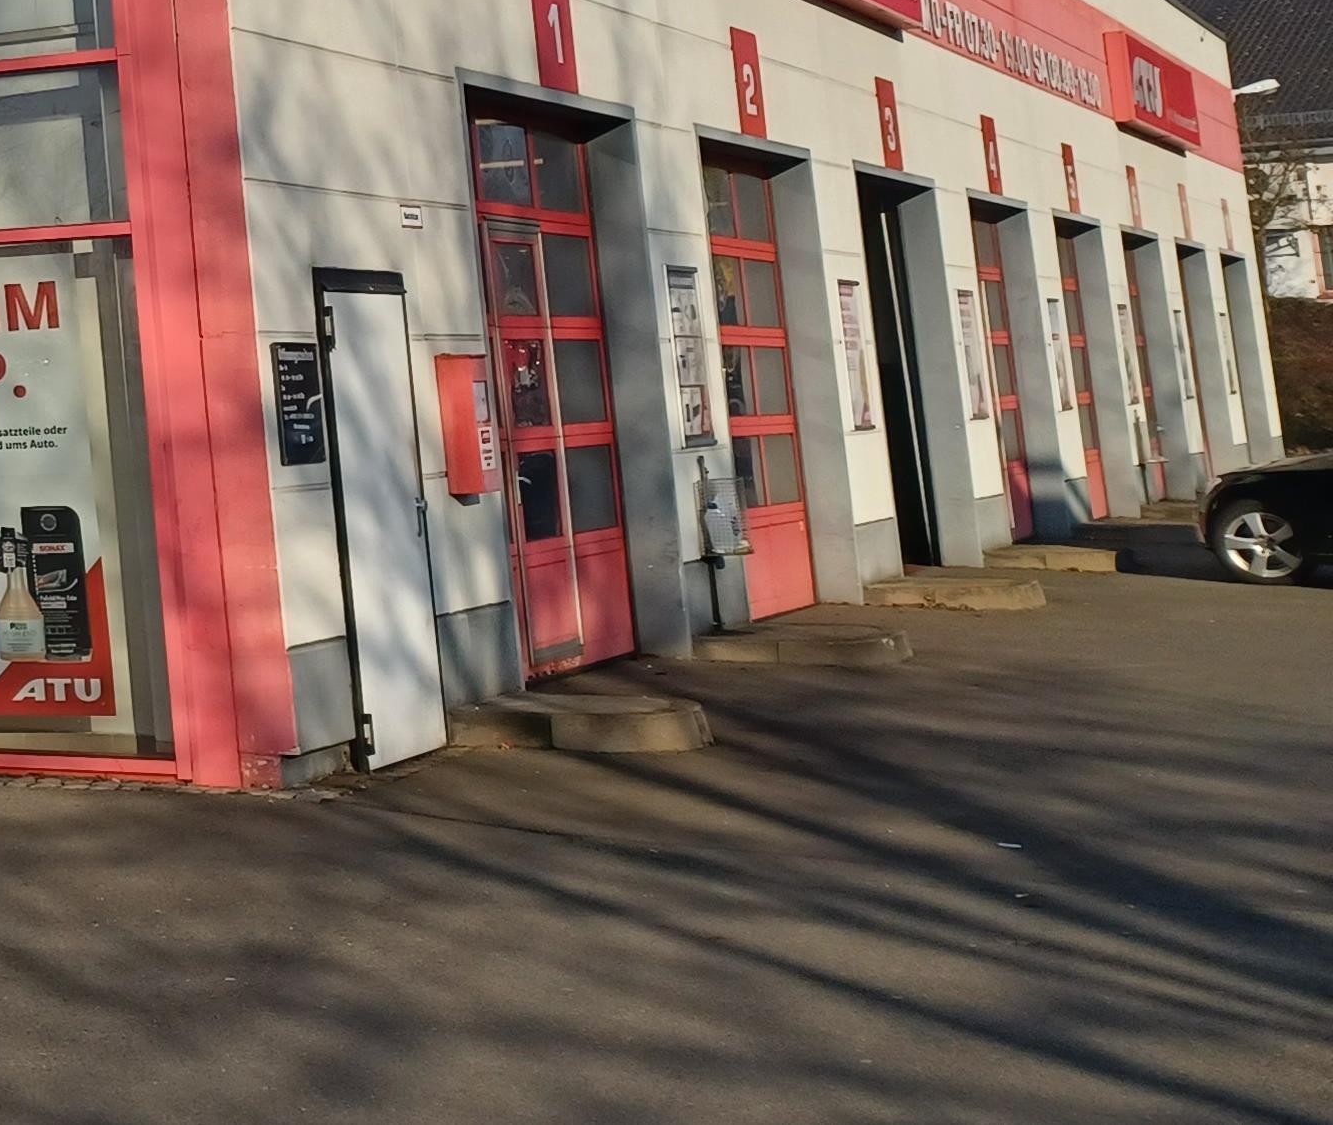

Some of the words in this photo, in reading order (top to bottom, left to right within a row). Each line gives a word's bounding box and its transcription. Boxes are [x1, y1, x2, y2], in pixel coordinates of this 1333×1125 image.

[547, 3, 565, 65] 1
[741, 63, 759, 115] 2
[885, 105, 897, 151] 3
[989, 139, 999, 179] 4
[11, 678, 102, 703] ATU
